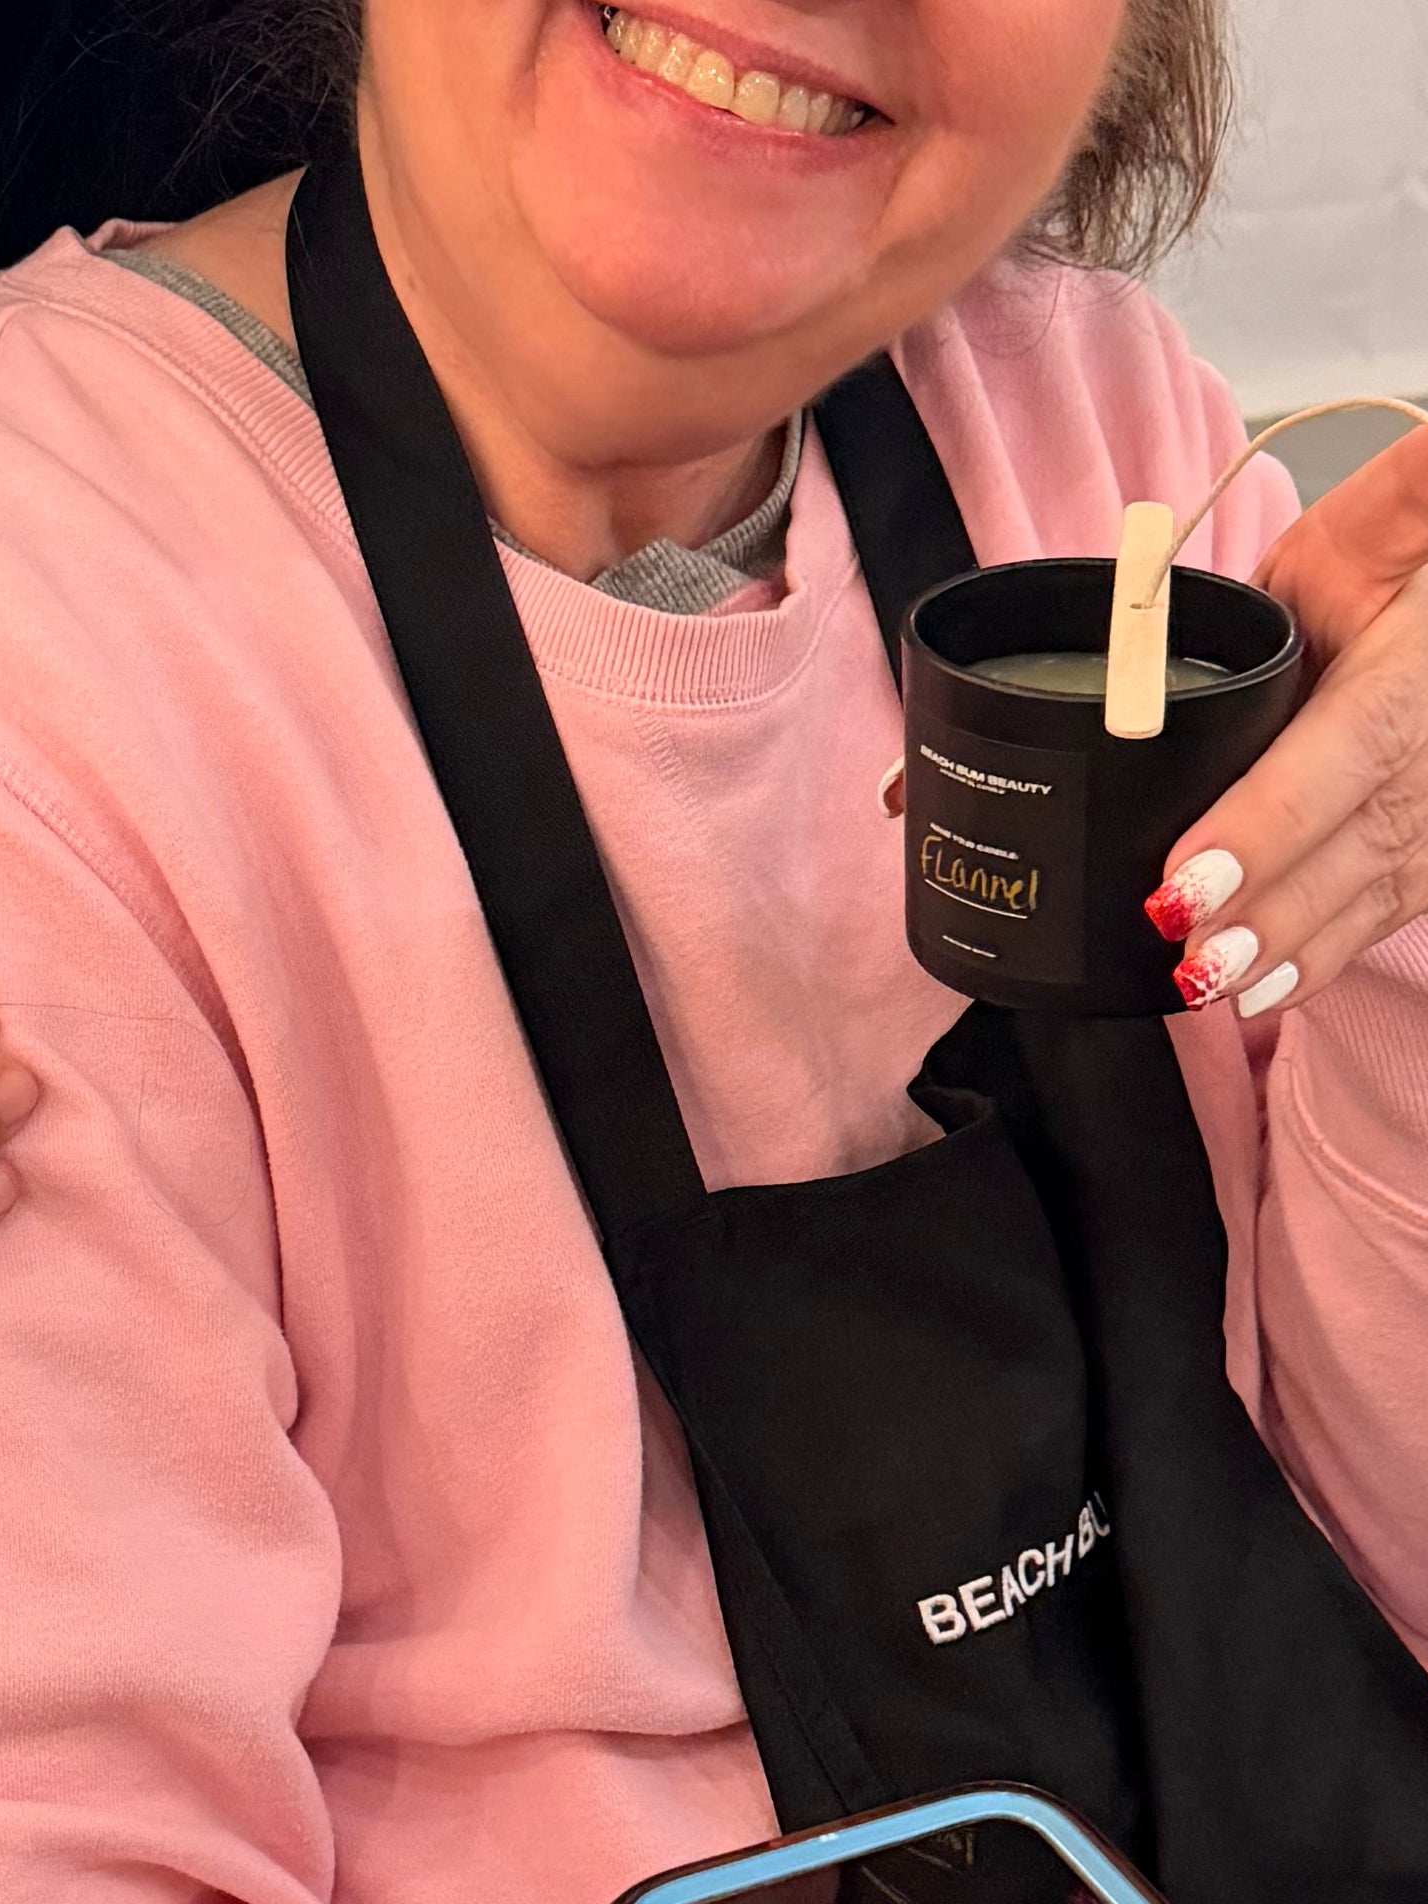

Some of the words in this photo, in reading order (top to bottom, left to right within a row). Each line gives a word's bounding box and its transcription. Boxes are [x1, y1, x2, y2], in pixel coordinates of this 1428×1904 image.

[955, 764, 985, 783] BUM
[987, 774, 1052, 795] BEAUTY
[917, 1533, 1075, 1646] BEACH
